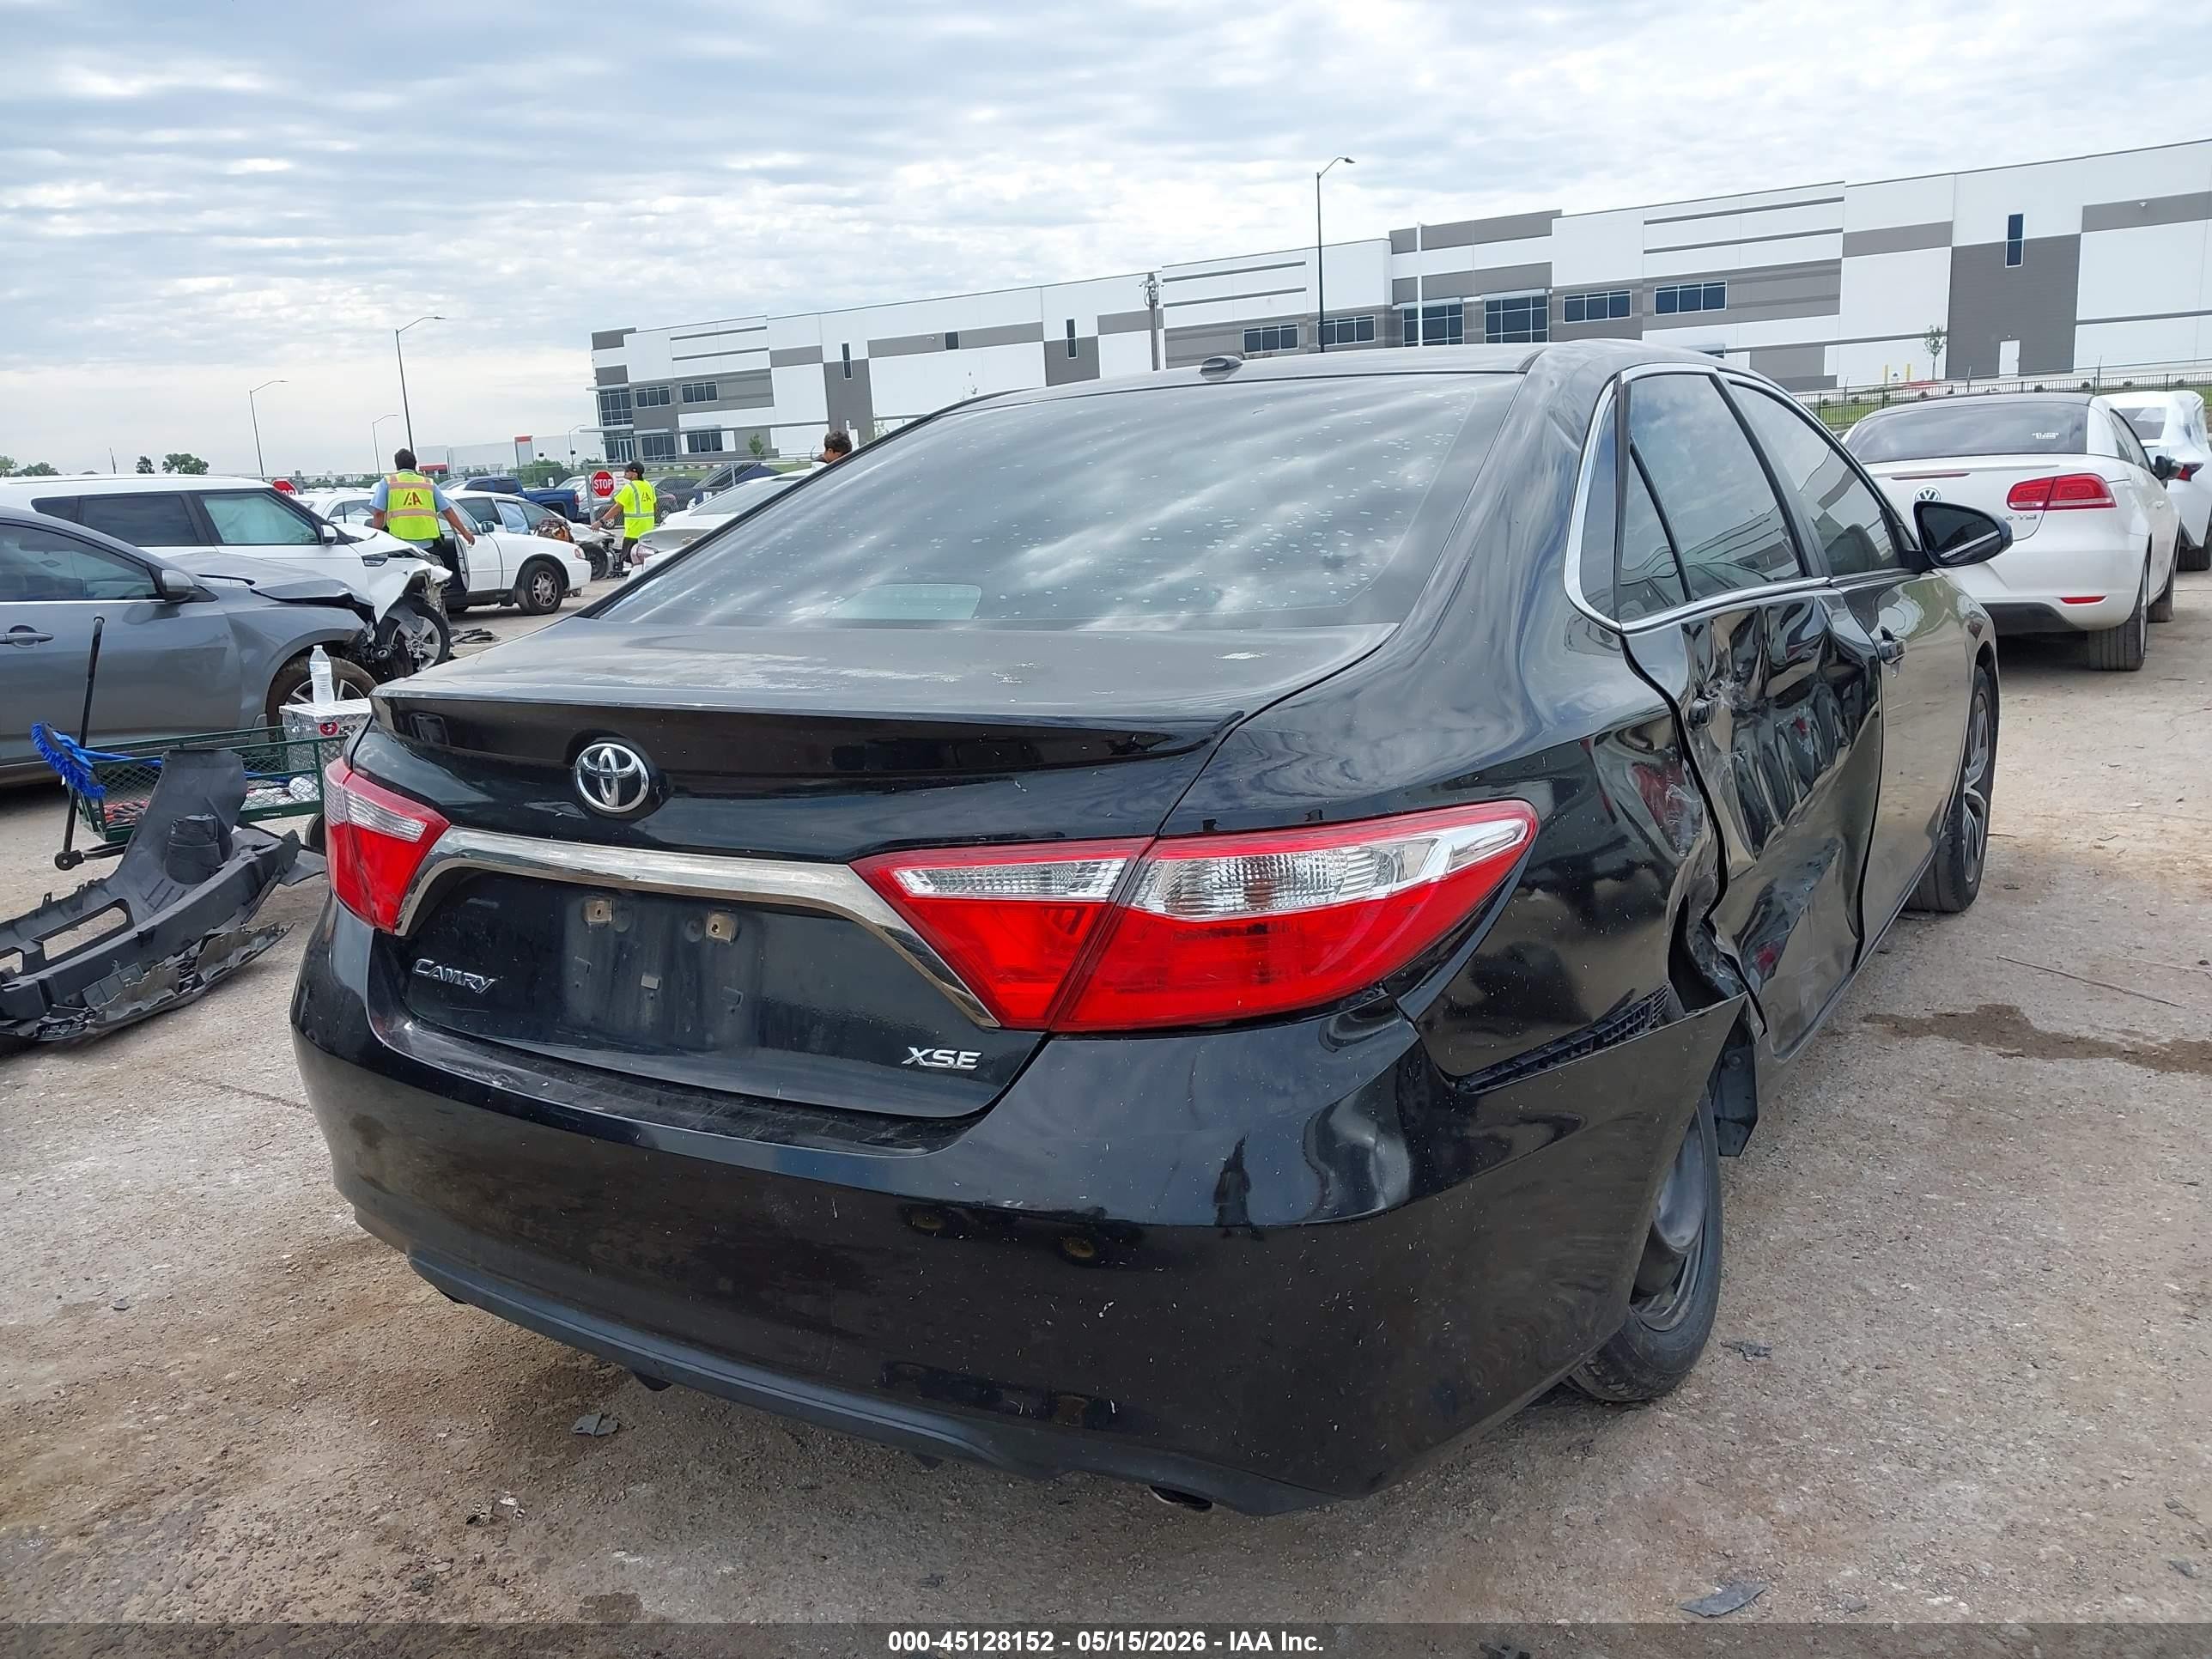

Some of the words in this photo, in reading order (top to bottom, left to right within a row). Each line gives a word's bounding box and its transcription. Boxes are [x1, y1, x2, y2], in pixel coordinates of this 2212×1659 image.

[593, 479, 612, 489] STOP
[412, 958, 495, 994] CAMRY
[901, 1047, 981, 1070] XSE
